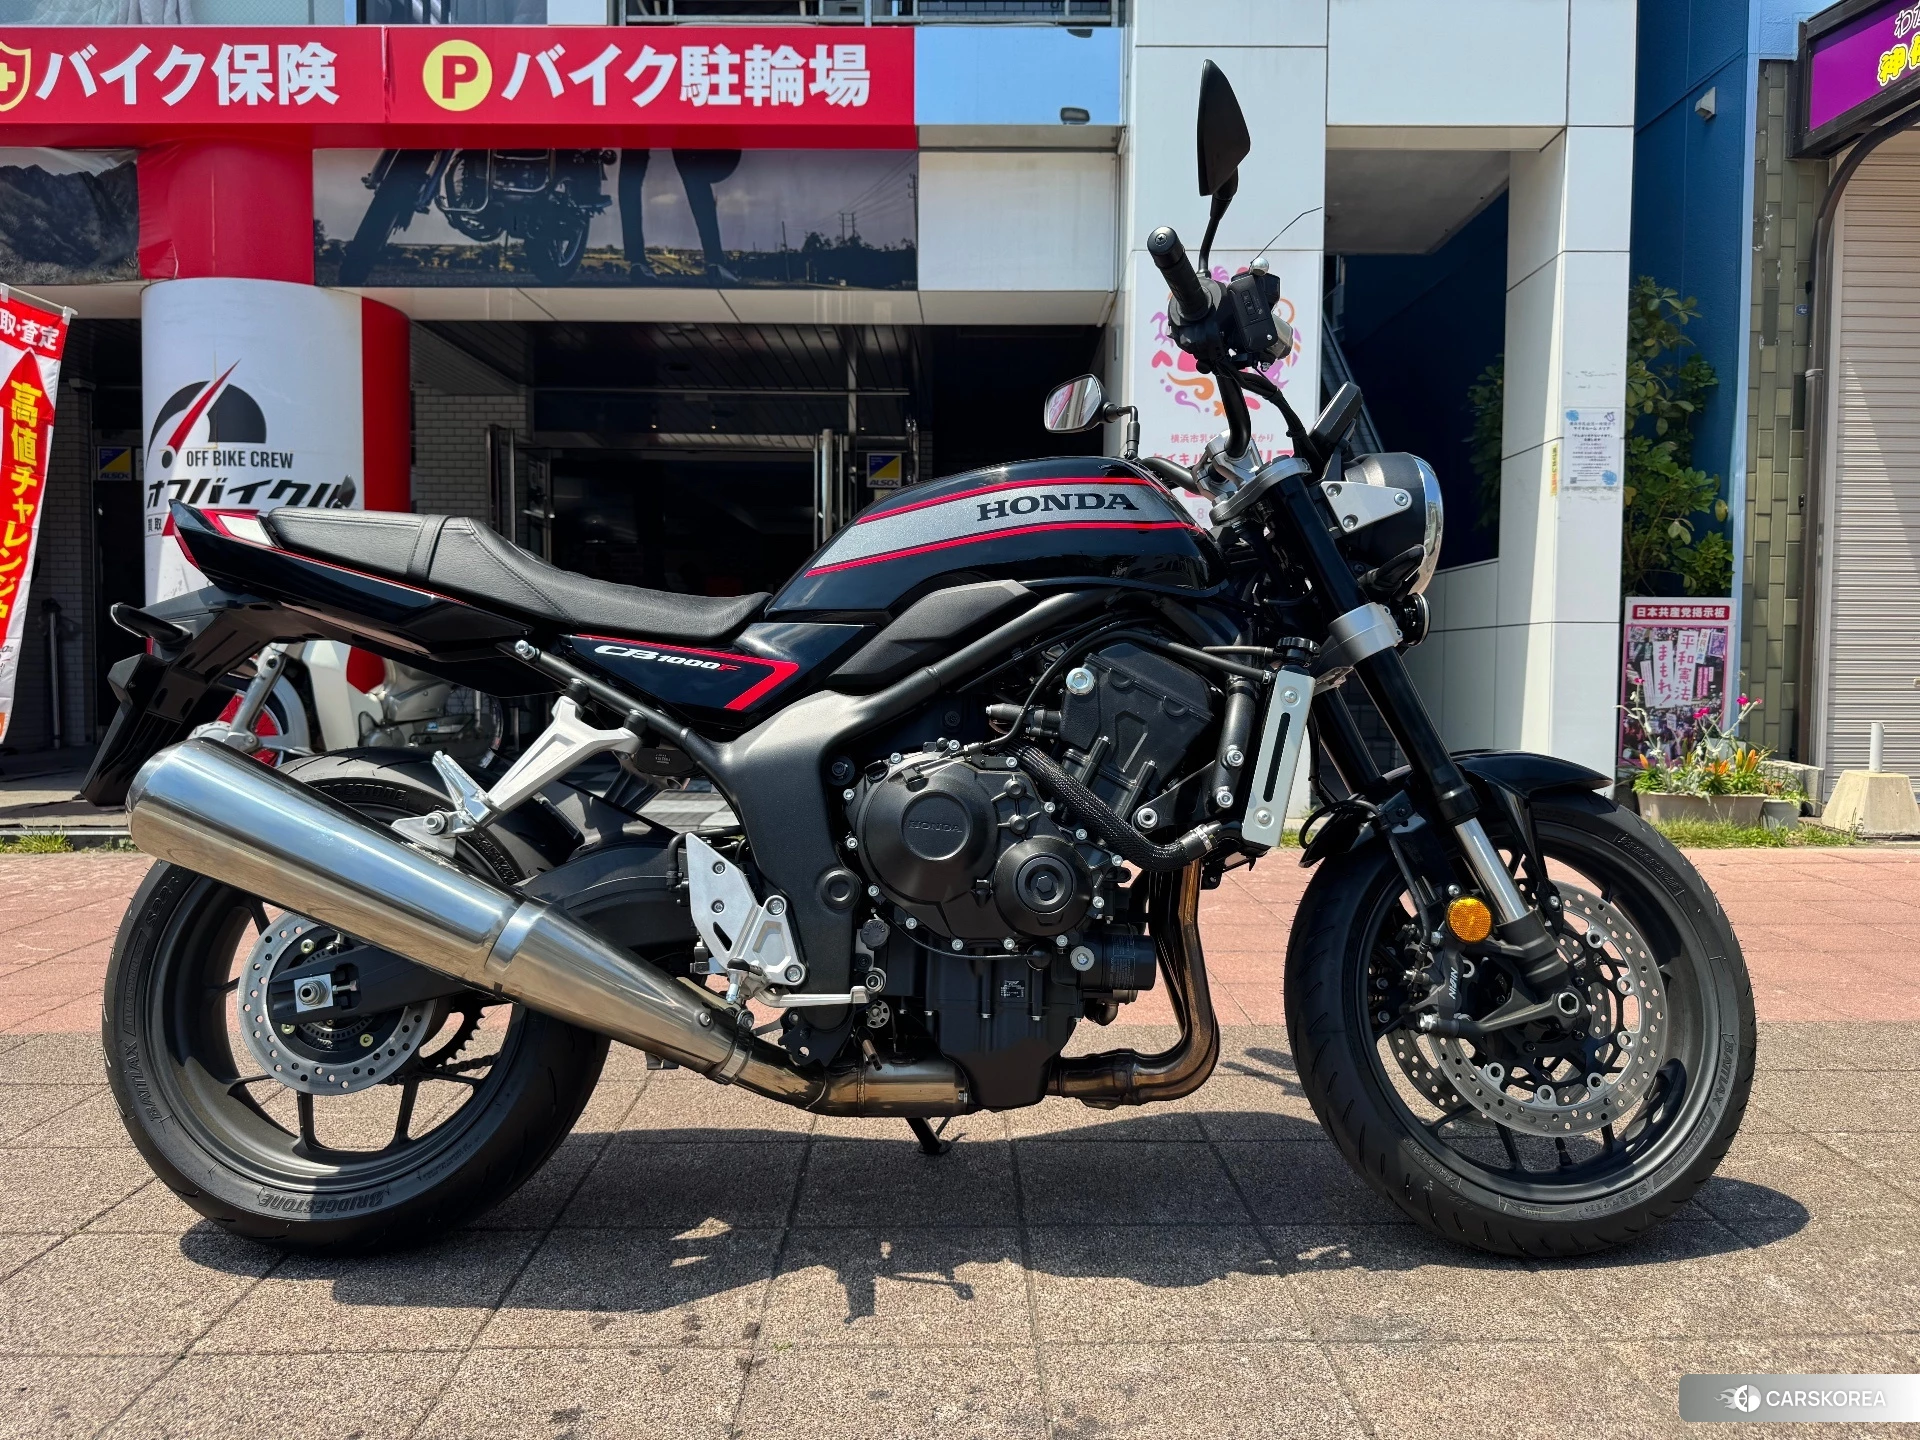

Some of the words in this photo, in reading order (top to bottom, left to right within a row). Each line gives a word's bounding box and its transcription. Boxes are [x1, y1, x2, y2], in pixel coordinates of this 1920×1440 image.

[35, 42, 340, 106] バイク保険
[442, 55, 479, 99] P
[501, 43, 871, 107] バイク駐輪場
[187, 451, 208, 467] OFF
[213, 451, 246, 467] BIKE
[250, 452, 293, 469] CREW
[976, 493, 1139, 521] HONDA
[1636, 607, 1725, 618] 日本共産党掲示板
[1674, 634, 1695, 702] 平和憲法
[908, 820, 963, 833] HONDA
[1448, 966, 1459, 1000] NISSIN
[260, 1190, 385, 1214] BRIDGESTONE
